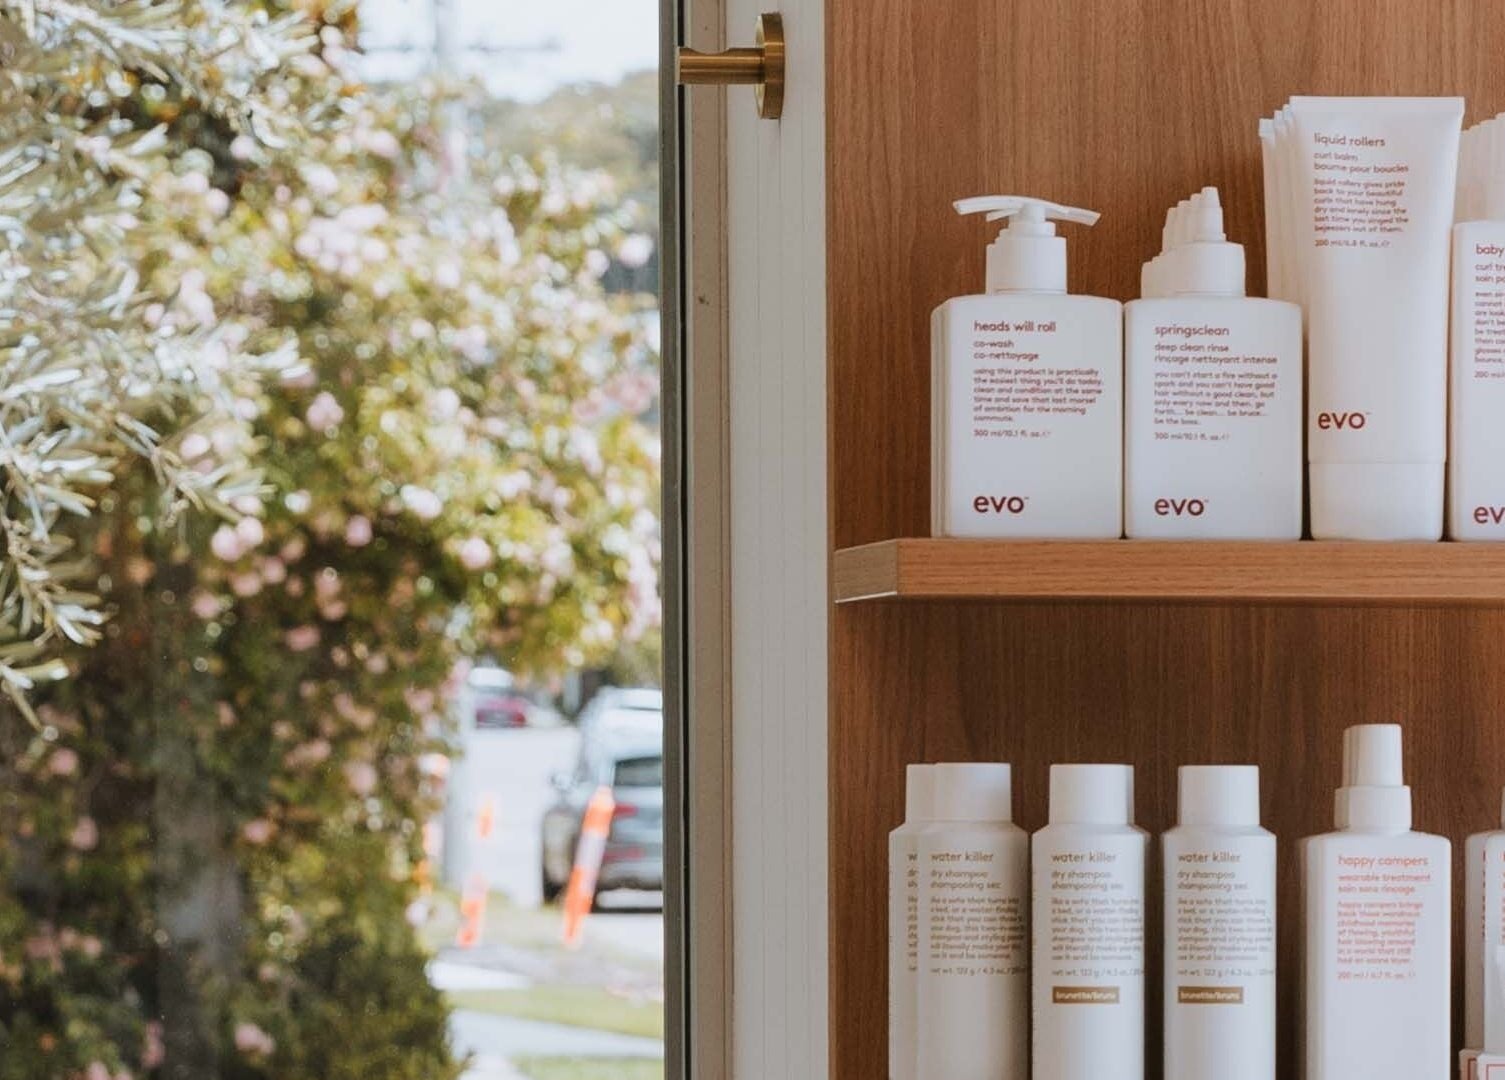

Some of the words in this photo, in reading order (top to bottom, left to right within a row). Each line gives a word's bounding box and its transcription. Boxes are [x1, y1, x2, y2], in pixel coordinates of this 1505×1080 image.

[1314, 133, 1346, 146] liquid
[1349, 136, 1386, 147] rollers
[1313, 152, 1332, 162] curl
[1334, 152, 1358, 162] balm
[1314, 162, 1347, 171] baume
[1373, 164, 1409, 174] boucles
[1476, 244, 1505, 258] baby
[1475, 263, 1493, 271] curl
[974, 320, 1010, 332] heads
[1013, 320, 1034, 332] will
[1037, 321, 1056, 332] roll
[1155, 324, 1230, 337] springsclean
[973, 340, 1014, 348] co-wash
[1155, 343, 1178, 352] deep
[1179, 343, 1205, 352] clean
[1207, 344, 1229, 352] rinse
[974, 352, 1039, 362] co-nettoyage
[1318, 412, 1365, 430] evo
[973, 496, 1024, 514] evo
[1154, 499, 1204, 516] evo
[931, 852, 962, 862] water
[965, 851, 994, 862] killer
[1051, 853, 1084, 863] water
[1089, 852, 1116, 862] killer
[1178, 853, 1209, 863] water
[1212, 852, 1240, 863] killer
[1338, 855, 1375, 868] happy
[1378, 856, 1429, 868] campers
[1338, 873, 1380, 882] wearable
[1382, 874, 1431, 882] treatment
